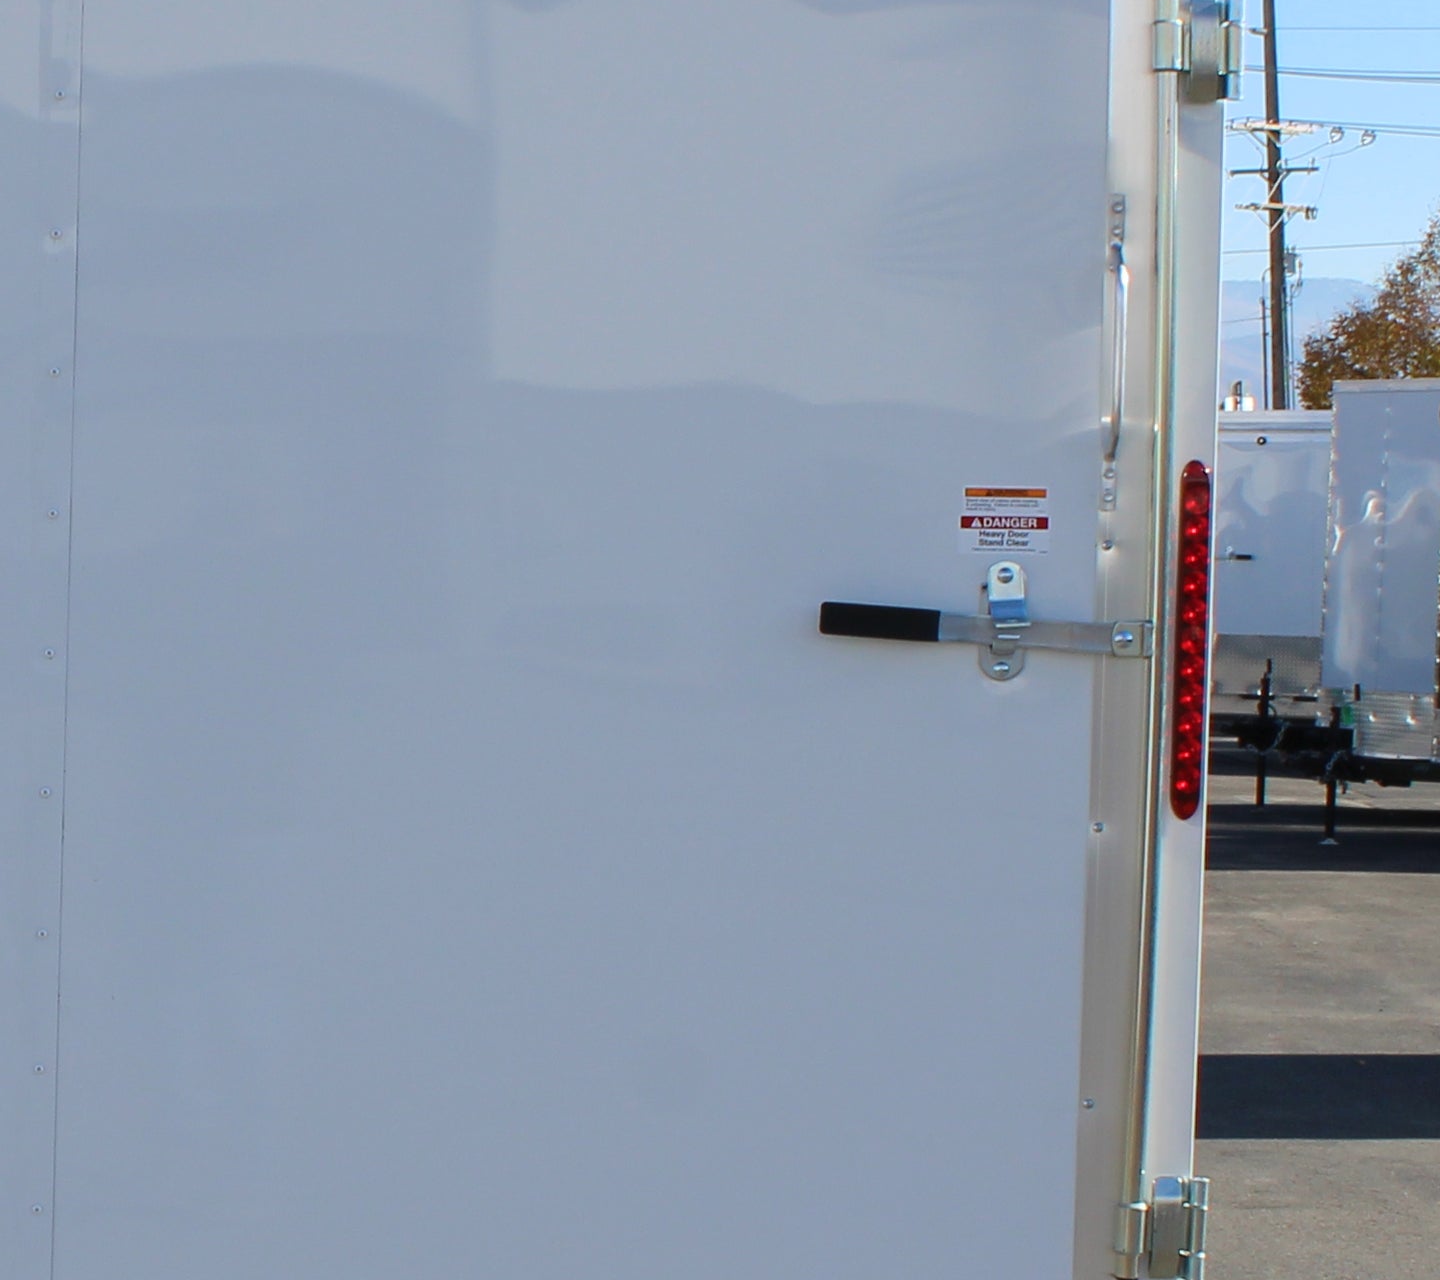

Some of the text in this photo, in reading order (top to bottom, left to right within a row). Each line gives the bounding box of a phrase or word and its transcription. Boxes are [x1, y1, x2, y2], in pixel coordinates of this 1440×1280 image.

[983, 517, 1038, 528] DANGER
[978, 530, 1029, 539] Heavy Door
[978, 538, 1029, 546] Stand Clear
